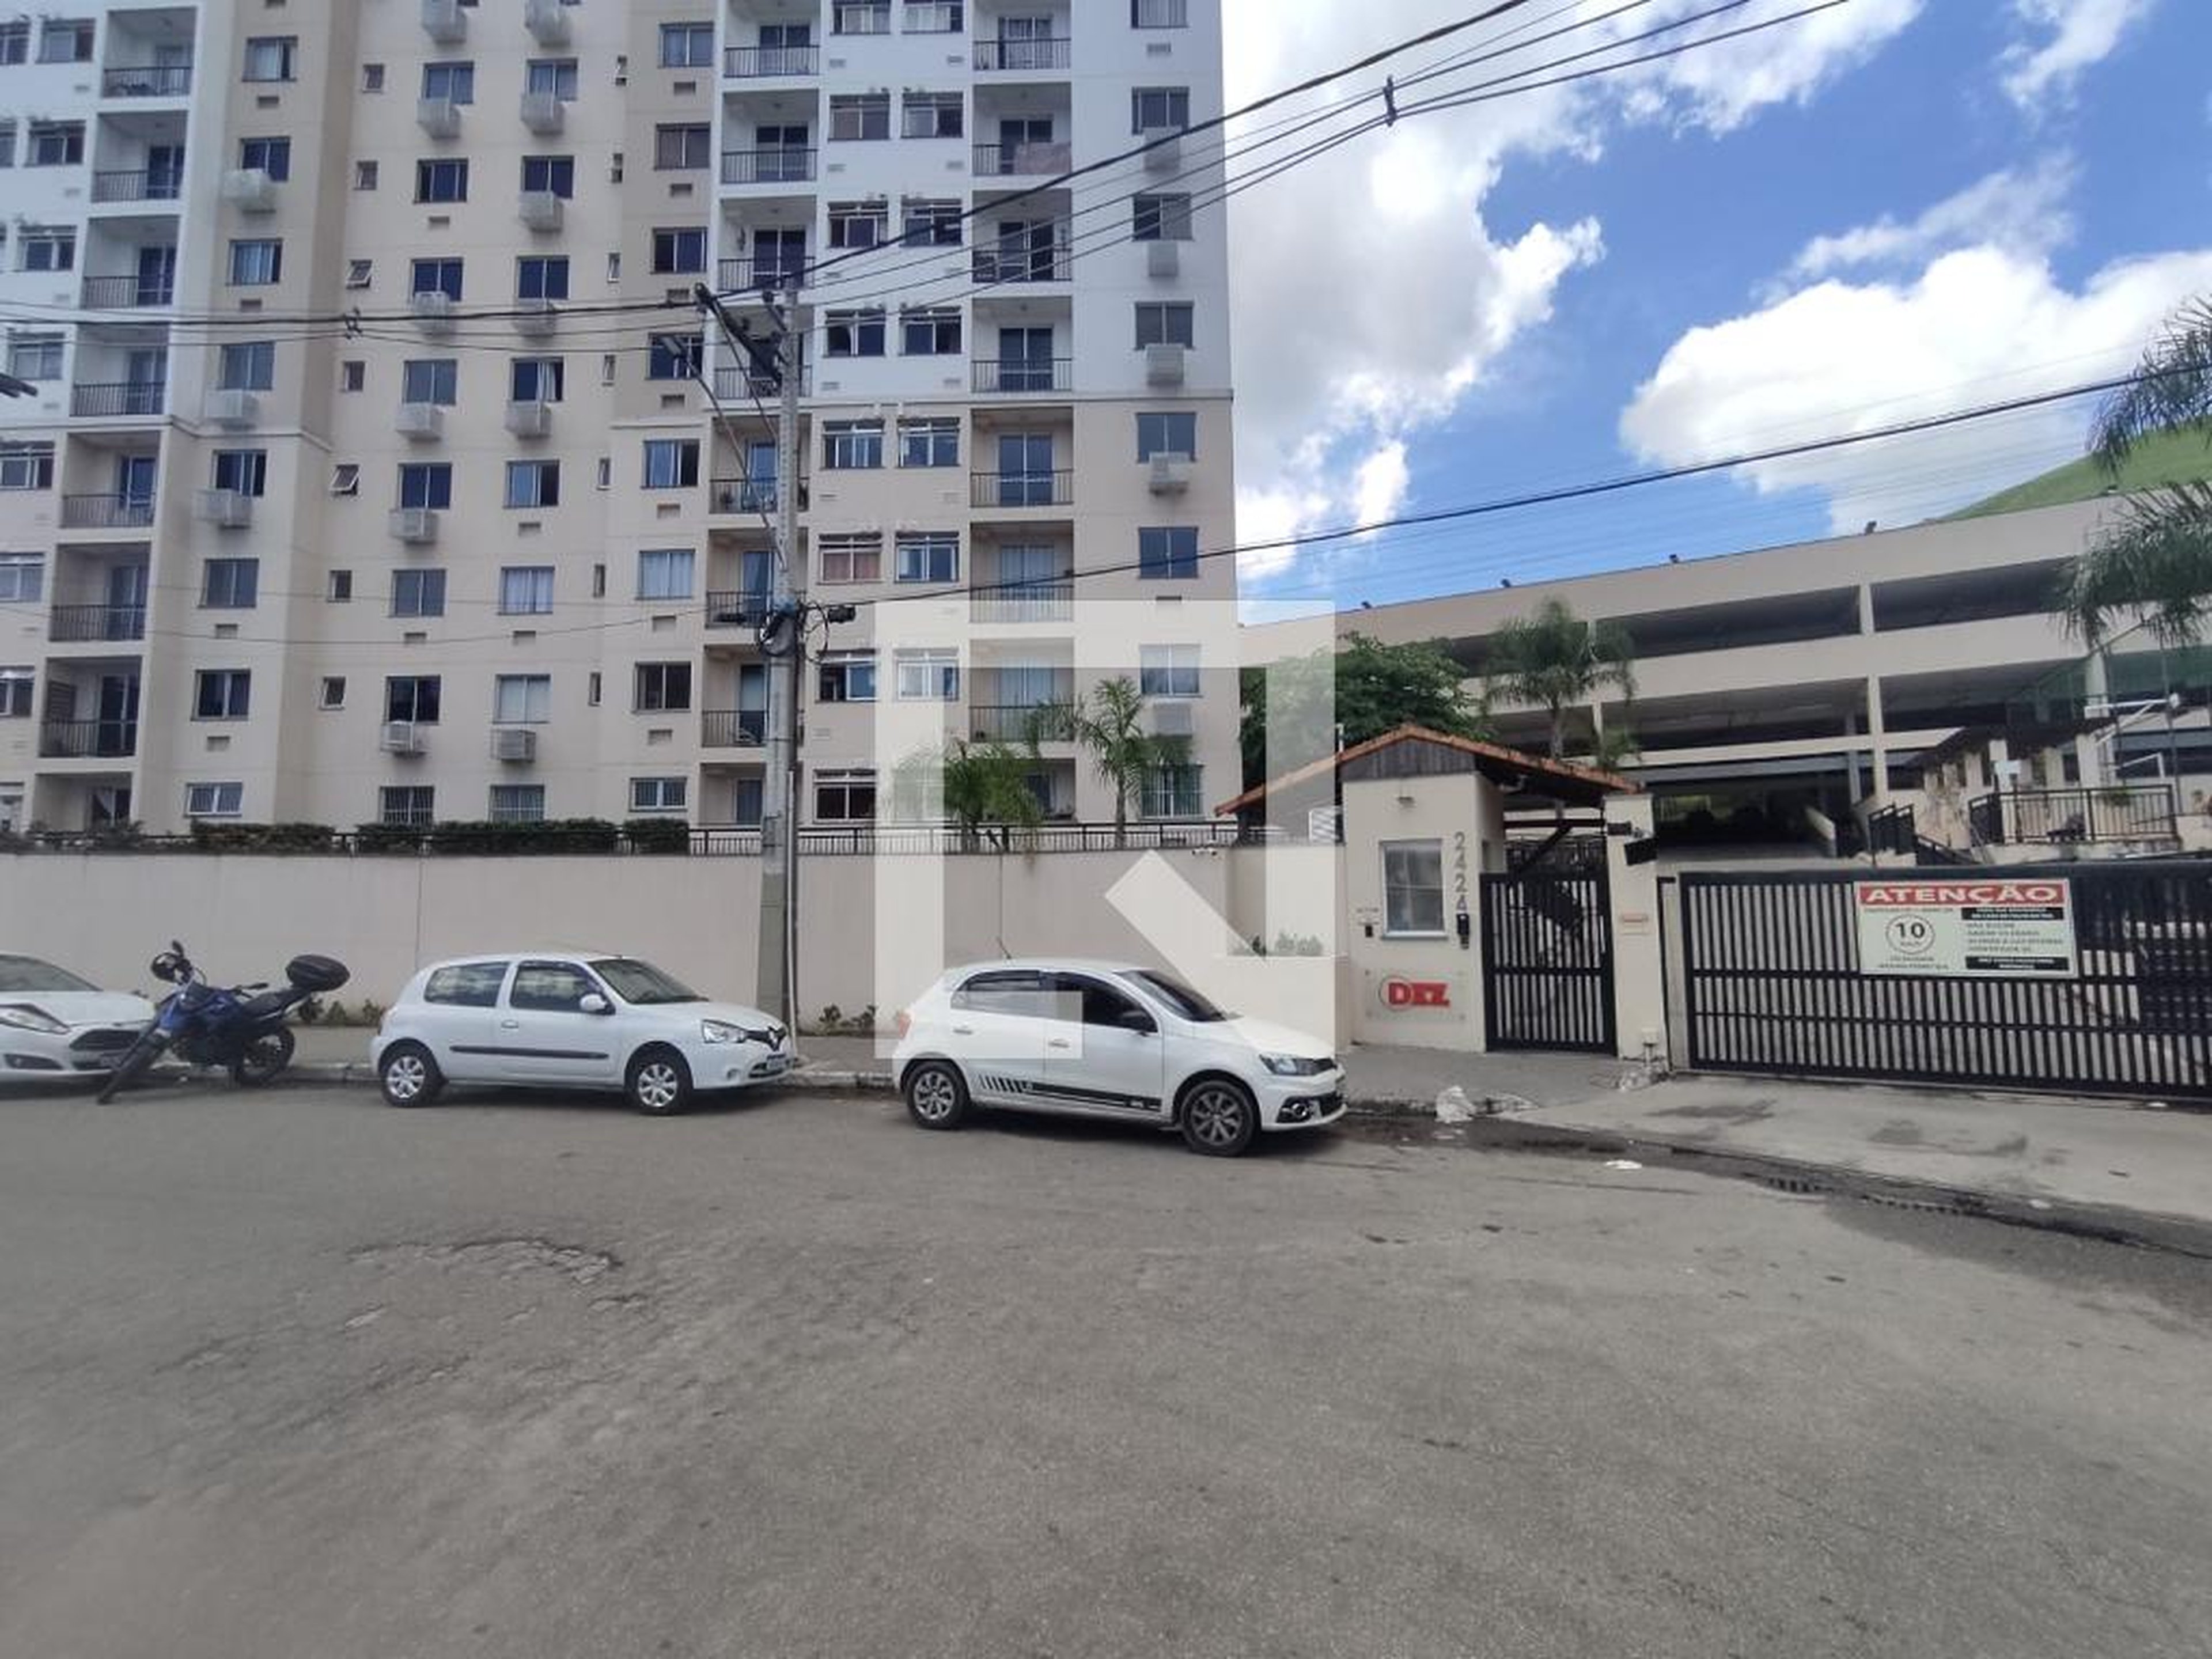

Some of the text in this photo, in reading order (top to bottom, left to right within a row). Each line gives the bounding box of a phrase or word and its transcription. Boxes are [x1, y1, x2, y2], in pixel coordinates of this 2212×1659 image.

[1455, 831, 1468, 911] 2424
[1865, 884, 2058, 906] ATENÇÃO
[1895, 922, 1926, 939] 10
